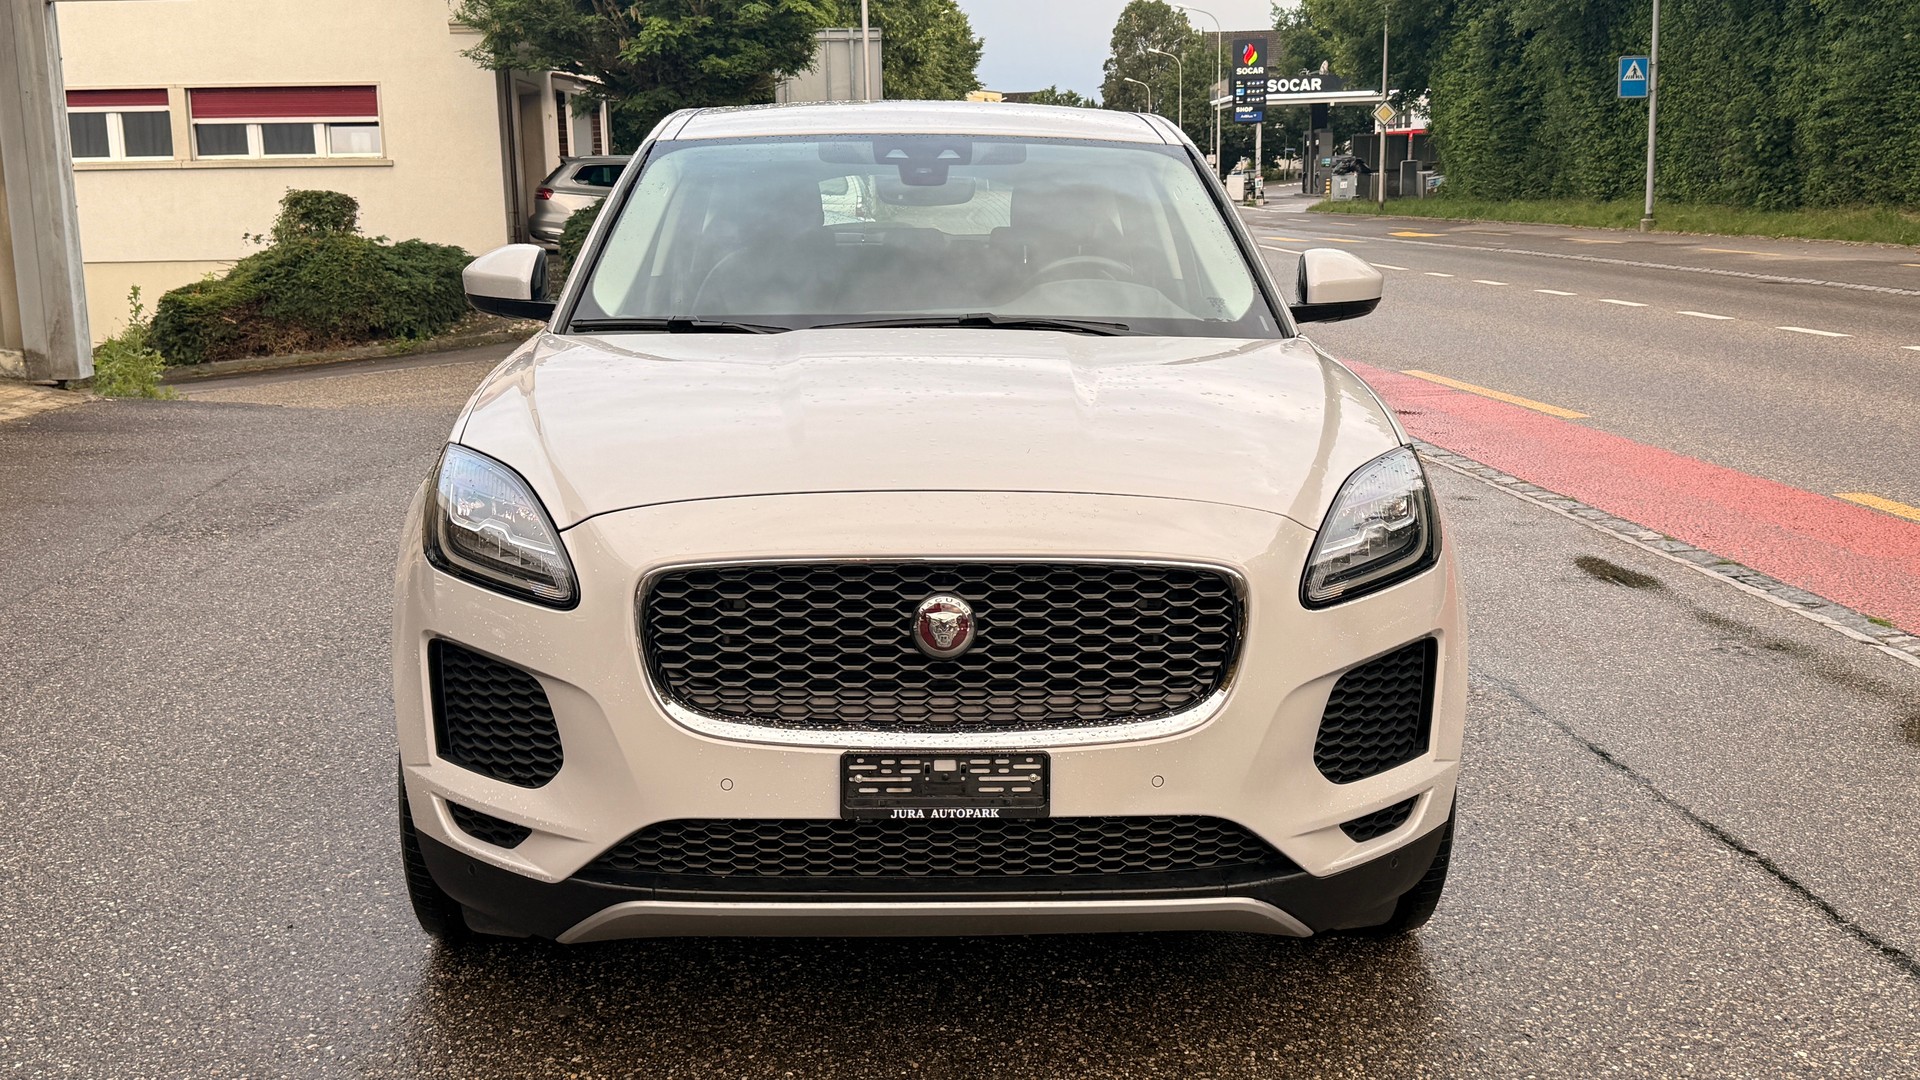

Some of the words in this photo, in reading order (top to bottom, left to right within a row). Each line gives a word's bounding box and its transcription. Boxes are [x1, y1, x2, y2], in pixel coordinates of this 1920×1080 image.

[1236, 67, 1264, 75] SOCAR
[1267, 78, 1322, 92] SOCAR
[919, 597, 971, 616] JAGUAR
[890, 809, 925, 819] JURA
[930, 808, 1000, 819] AUTOPARK
